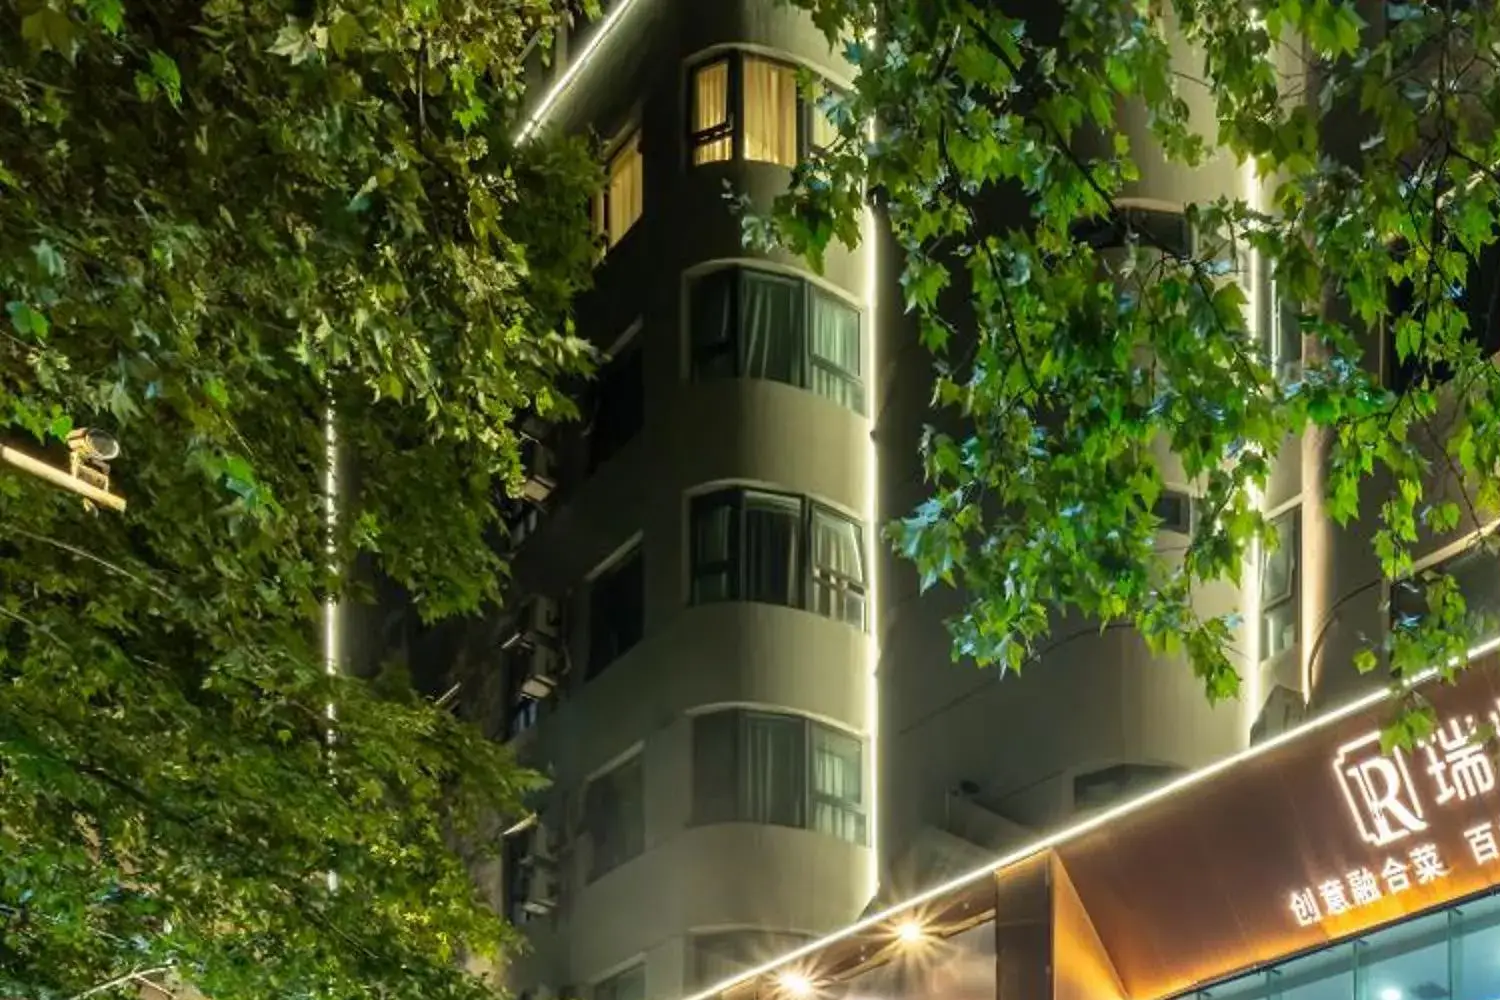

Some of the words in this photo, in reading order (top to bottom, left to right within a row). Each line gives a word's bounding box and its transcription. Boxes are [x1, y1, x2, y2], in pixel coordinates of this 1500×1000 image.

[1288, 842, 1450, 927] 创意融合菜
